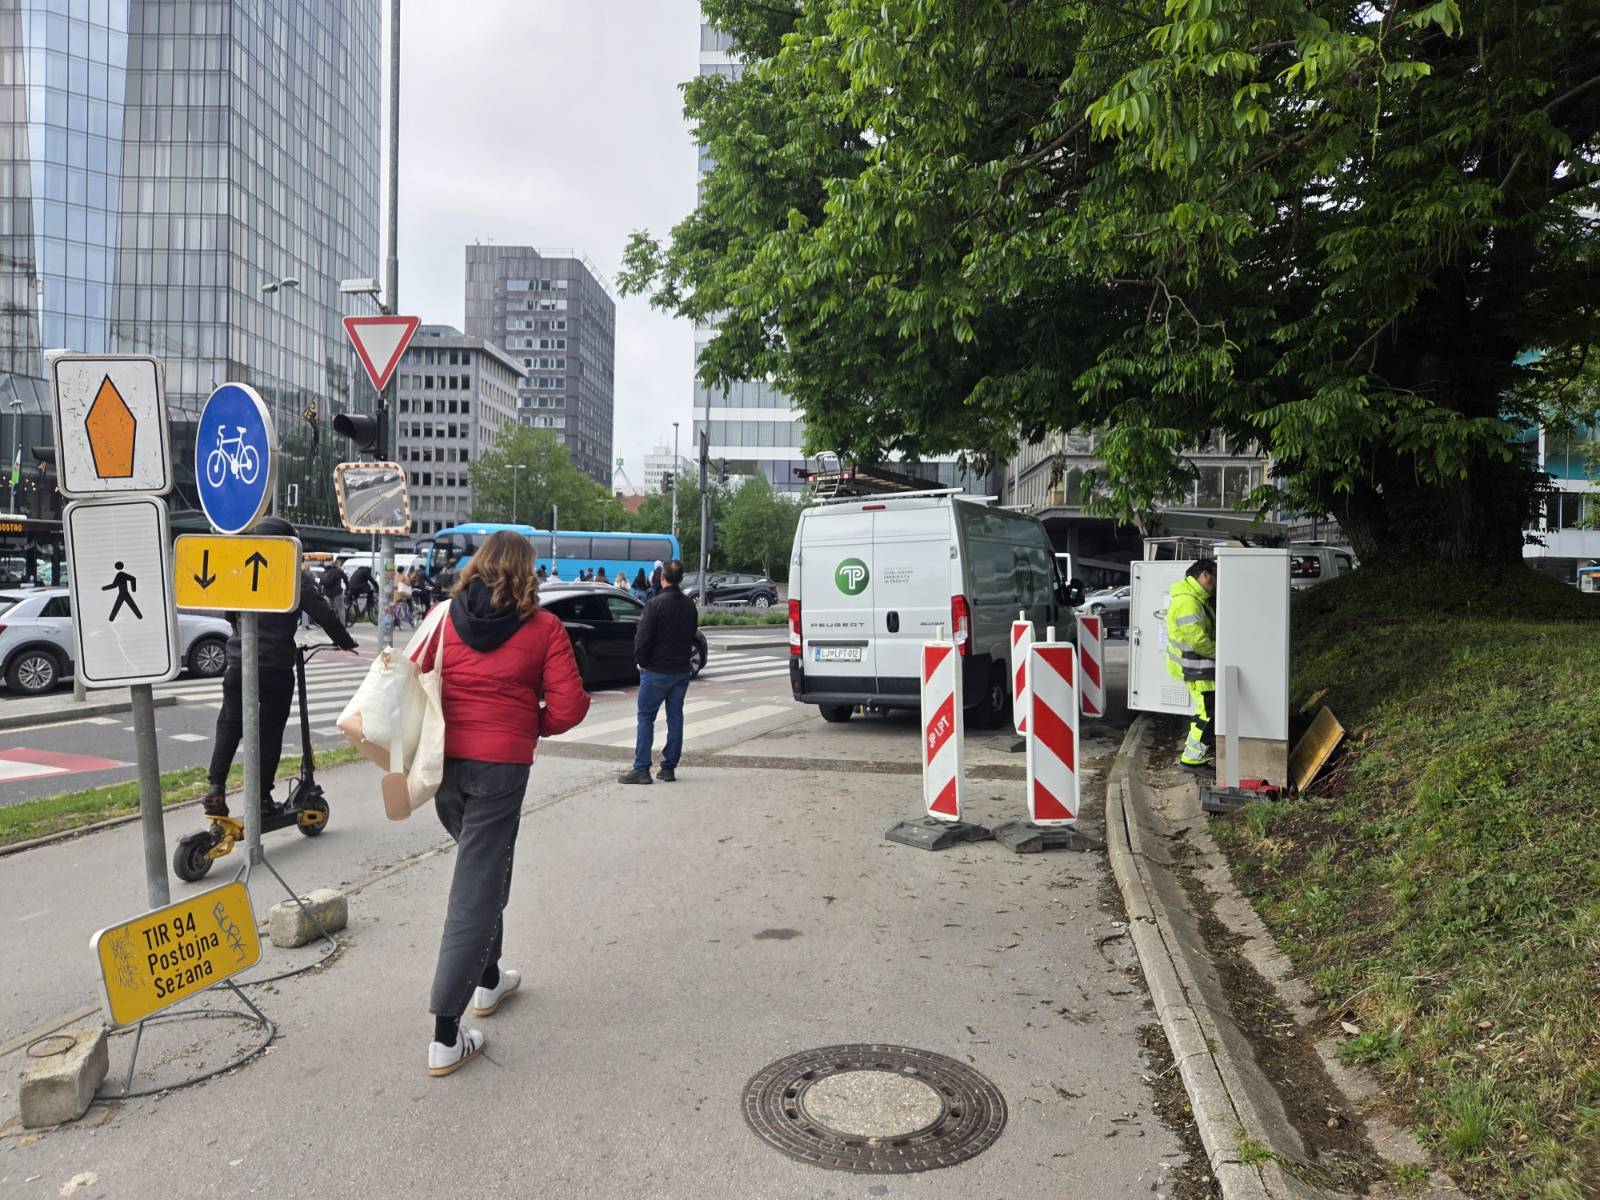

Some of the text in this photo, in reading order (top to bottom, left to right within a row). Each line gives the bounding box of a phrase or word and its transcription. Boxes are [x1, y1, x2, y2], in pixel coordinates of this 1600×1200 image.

[934, 715, 950, 737] LPT
[142, 923, 171, 951] TIR
[173, 911, 196, 938] 94
[147, 932, 219, 976] Postojna
[154, 960, 213, 999] Sežana
